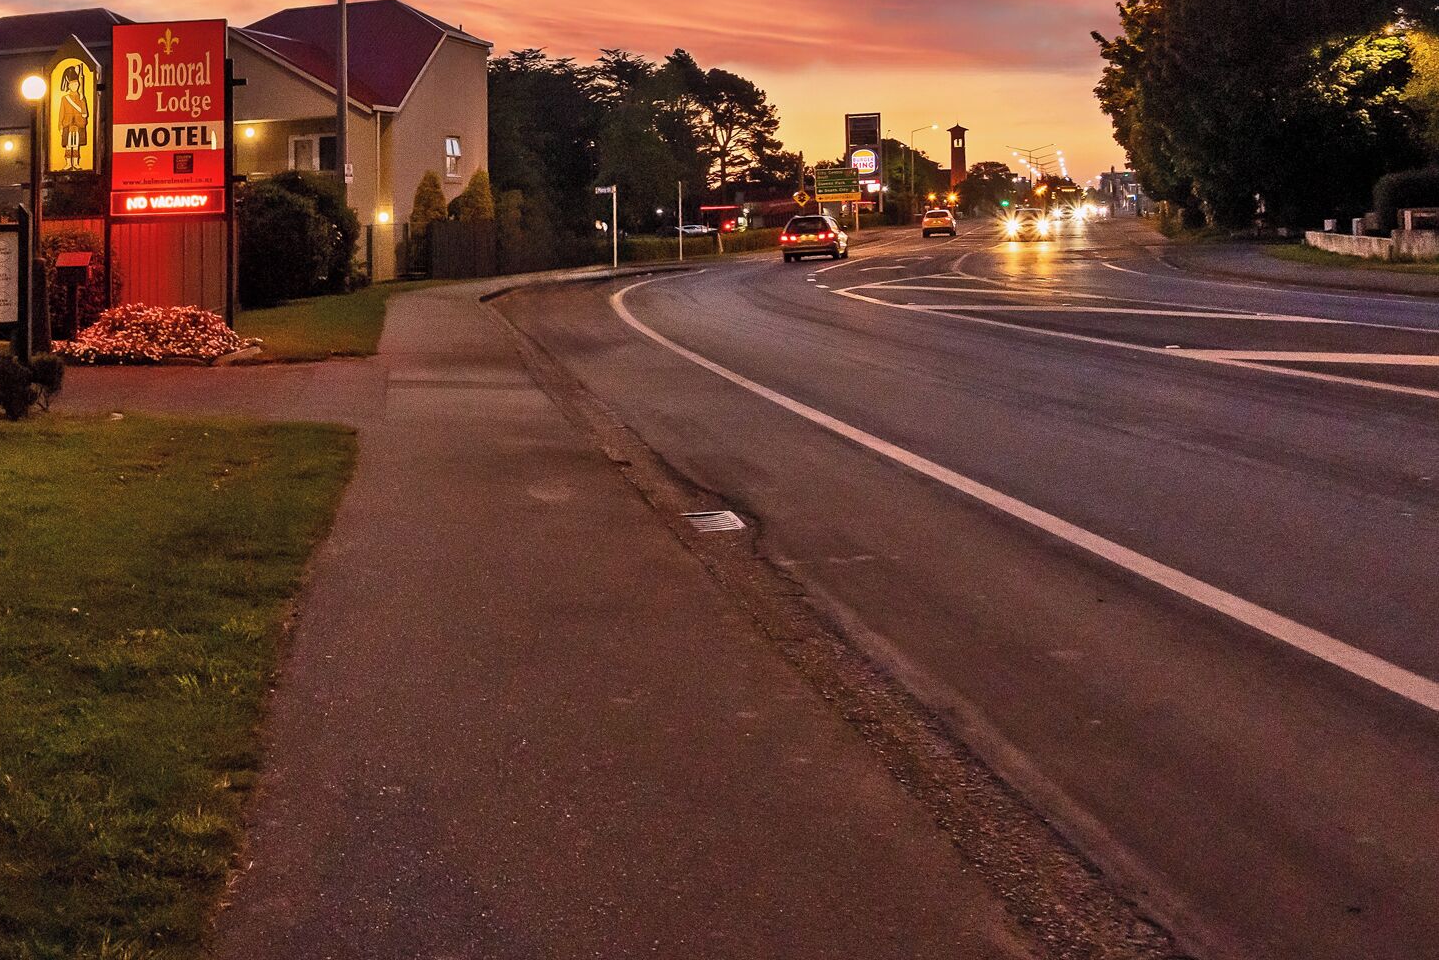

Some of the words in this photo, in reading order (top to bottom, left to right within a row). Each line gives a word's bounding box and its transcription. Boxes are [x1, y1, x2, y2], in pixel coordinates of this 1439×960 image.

[126, 51, 211, 100] Balmoral
[156, 89, 211, 118] Lodge
[125, 126, 212, 148] MOTEL
[126, 196, 148, 210] NO
[149, 195, 208, 209] VACANCY
